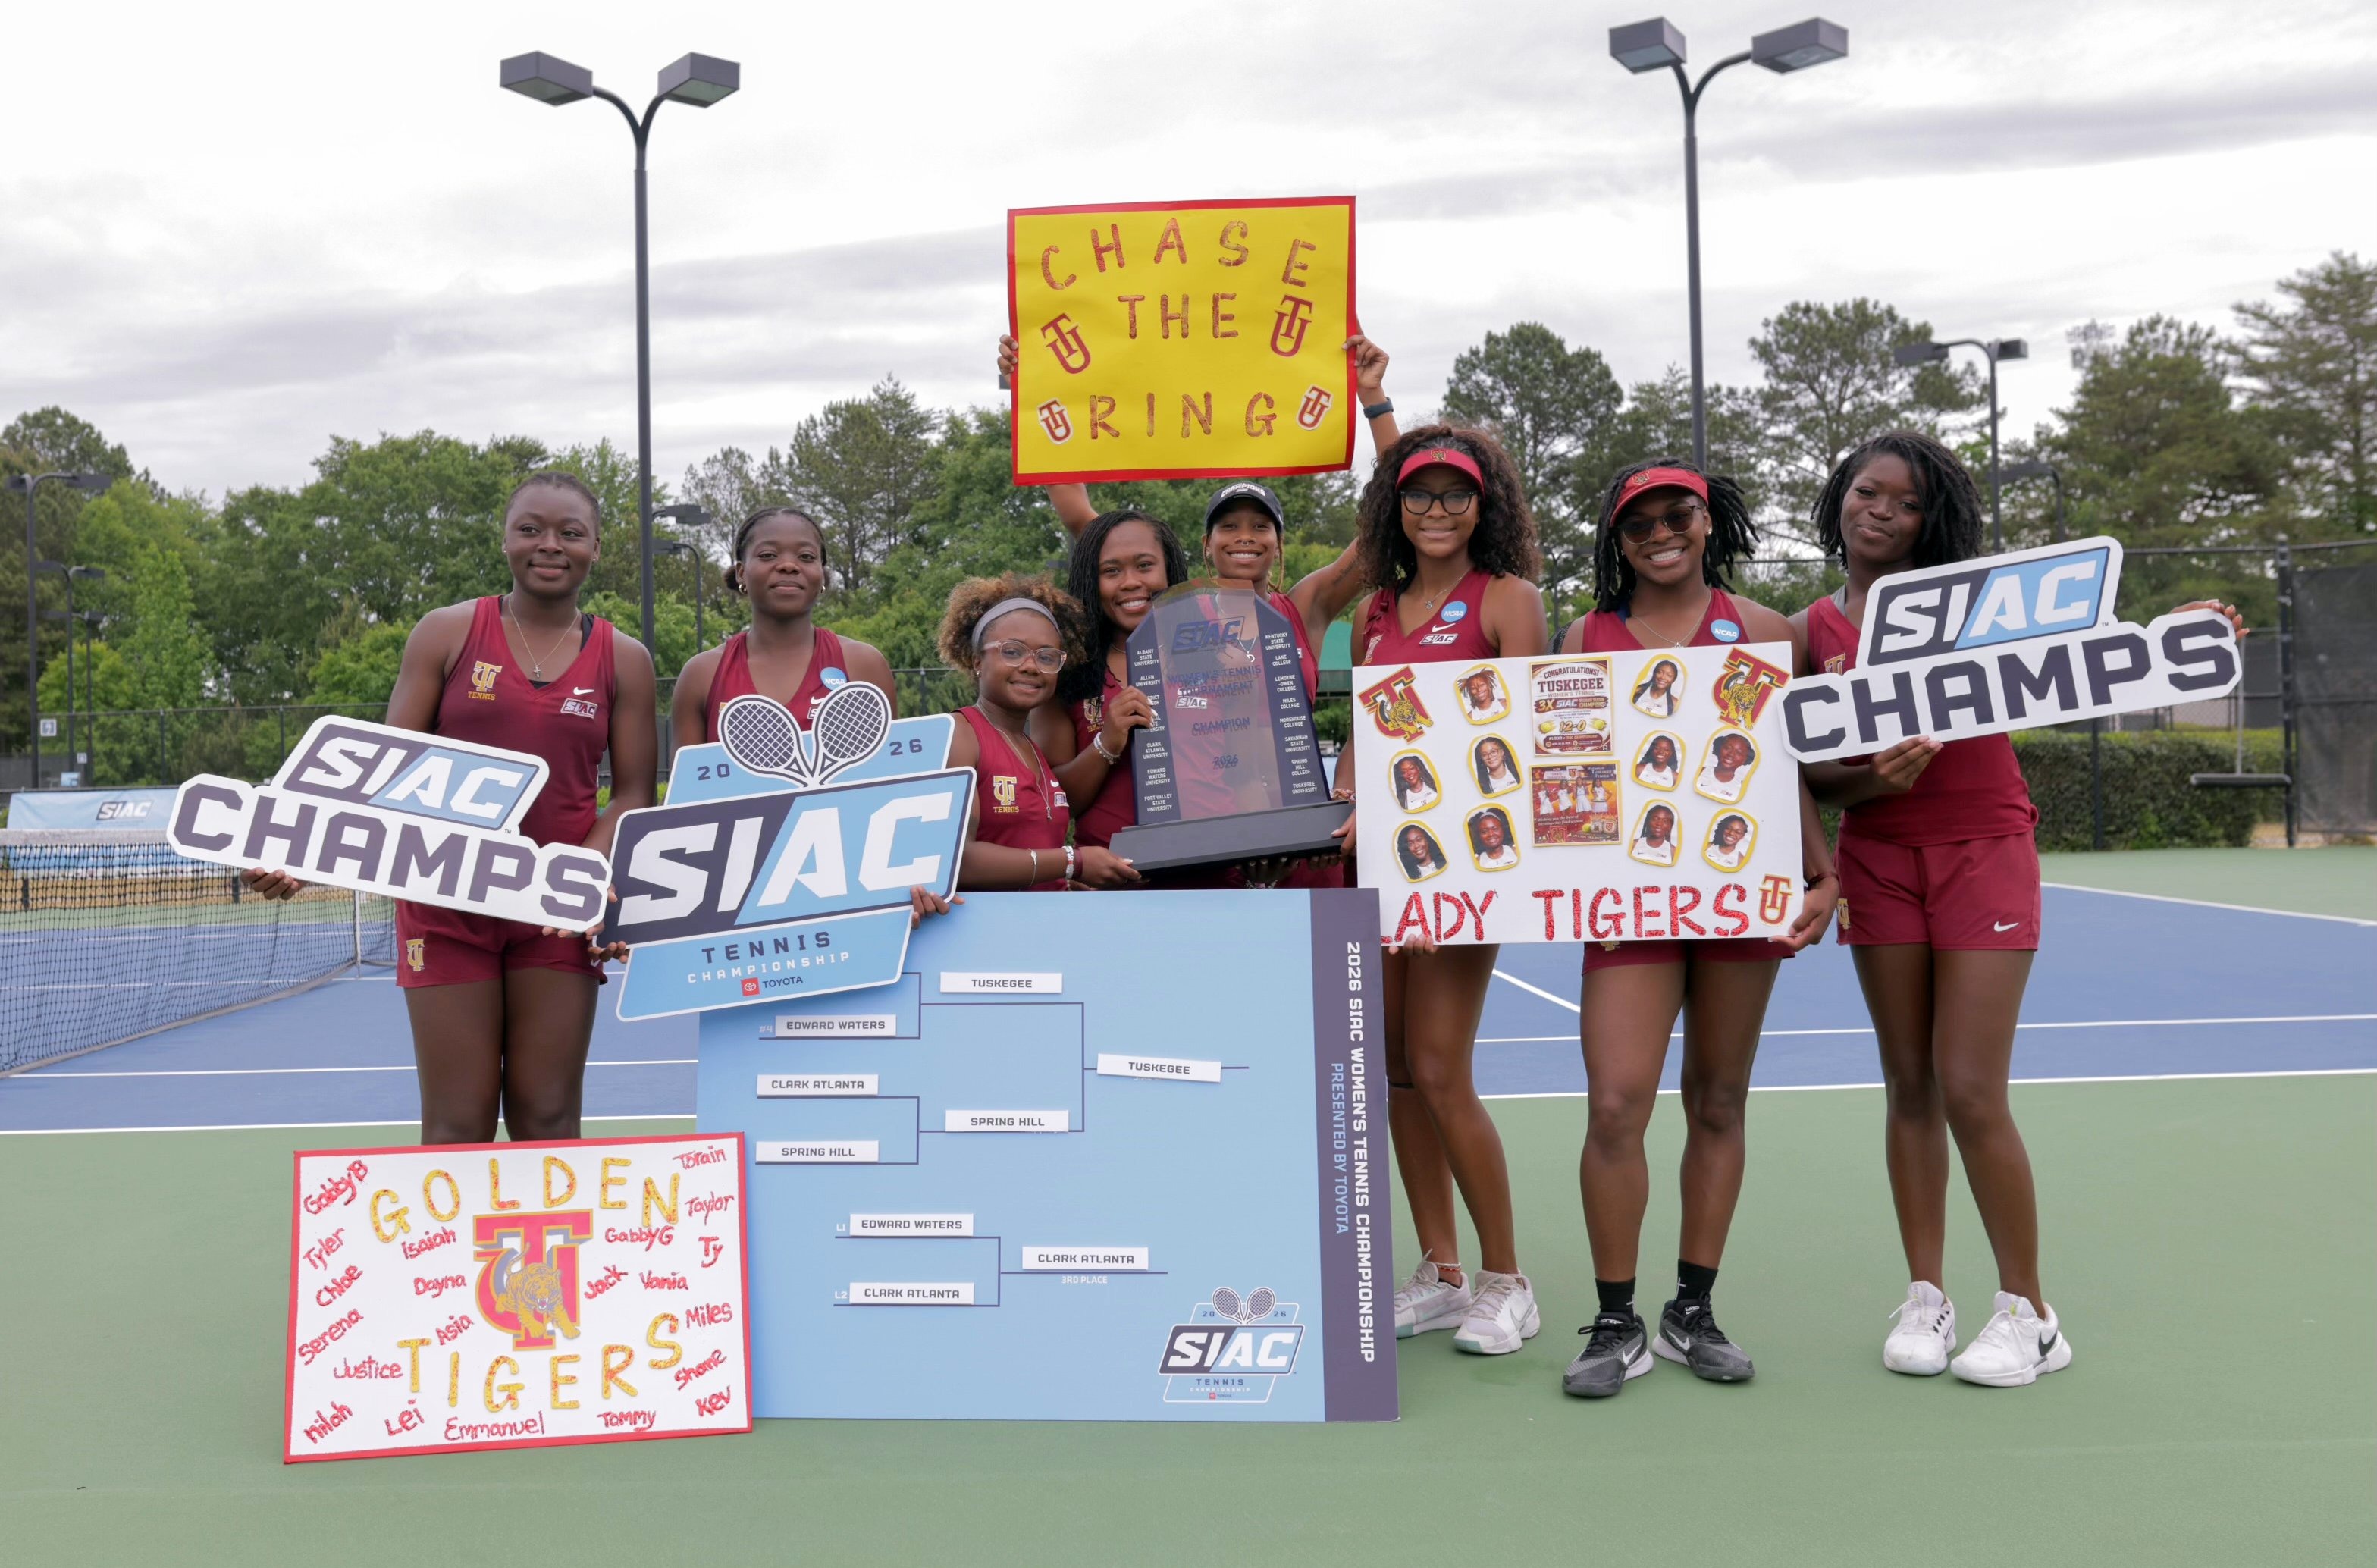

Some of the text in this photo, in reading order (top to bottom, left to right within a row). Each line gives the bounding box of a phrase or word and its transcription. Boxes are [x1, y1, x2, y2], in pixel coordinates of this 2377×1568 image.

[1041, 218, 1316, 290] CHASE
[1118, 293, 1240, 339] THE
[1090, 391, 1278, 440] RING
[1881, 560, 2097, 653] SIAC
[1422, 634, 1456, 644] SIAC
[1714, 628, 1737, 638] NCAA
[1223, 665, 1262, 677] TENNIS
[1543, 666, 1600, 679] CONGRATULATIONS!
[468, 691, 496, 700] TENNIS
[1538, 678, 1604, 693] TUSKEGEE
[1783, 619, 2237, 753] CHAMPS
[564, 701, 597, 716] SIAC
[1177, 697, 1207, 708] SIAC
[1538, 699, 1579, 712] 3X SIAC
[1193, 717, 1250, 732] CHAMPION
[1560, 720, 1586, 732] 12-0
[697, 738, 923, 781] 20 26
[1213, 756, 1239, 766] 2026
[299, 735, 525, 820] SIAC
[98, 801, 152, 818] SIAC
[173, 782, 607, 923] CHAMPS
[617, 792, 953, 926] SIAC
[1381, 883, 1749, 942] ADY TIGERS
[702, 932, 830, 964] TENNIS
[688, 952, 850, 983] CHAMPIONSHIP
[762, 975, 804, 989] TOYOTA
[971, 978, 1033, 988] TUSKEGEE
[786, 1020, 886, 1030] EDWARD WATERS
[1128, 1062, 1190, 1074] TUSKEGEE
[771, 1080, 864, 1090] CLARK ATLANTA
[971, 1117, 1045, 1127] SPRING HILL
[782, 1147, 855, 1157] SPRING HILL
[1331, 1063, 1349, 1234] PRESENTED BY TOYOTA
[1347, 942, 1375, 1363] 2026 SIAC WOMEN'S TENNIS CHAMPIONSHIP
[370, 1156, 680, 1243] GOLDEN
[685, 1191, 735, 1226] Taylor
[861, 1219, 963, 1229] EDWARD WATERS
[303, 1228, 345, 1270] Tyler
[401, 1226, 456, 1260] Isaiah
[605, 1225, 675, 1252] GabbyG
[698, 1236, 724, 1269] Ty
[1037, 1253, 1134, 1265] CLARK ATLANTA
[316, 1264, 363, 1306] Chloe
[413, 1274, 467, 1298] Dayna
[584, 1265, 629, 1300] Jack
[834, 1291, 848, 1300] L2
[864, 1288, 960, 1299] CLARK ATLANTA
[685, 1302, 733, 1329] Miles
[298, 1309, 364, 1366] Serena
[435, 1315, 474, 1346] Asia
[397, 1312, 683, 1413] TIGERS
[1167, 1332, 1296, 1367] SIAC
[334, 1355, 403, 1379] Justice
[674, 1349, 727, 1391] Shane
[444, 1411, 546, 1441] Emmanuel
